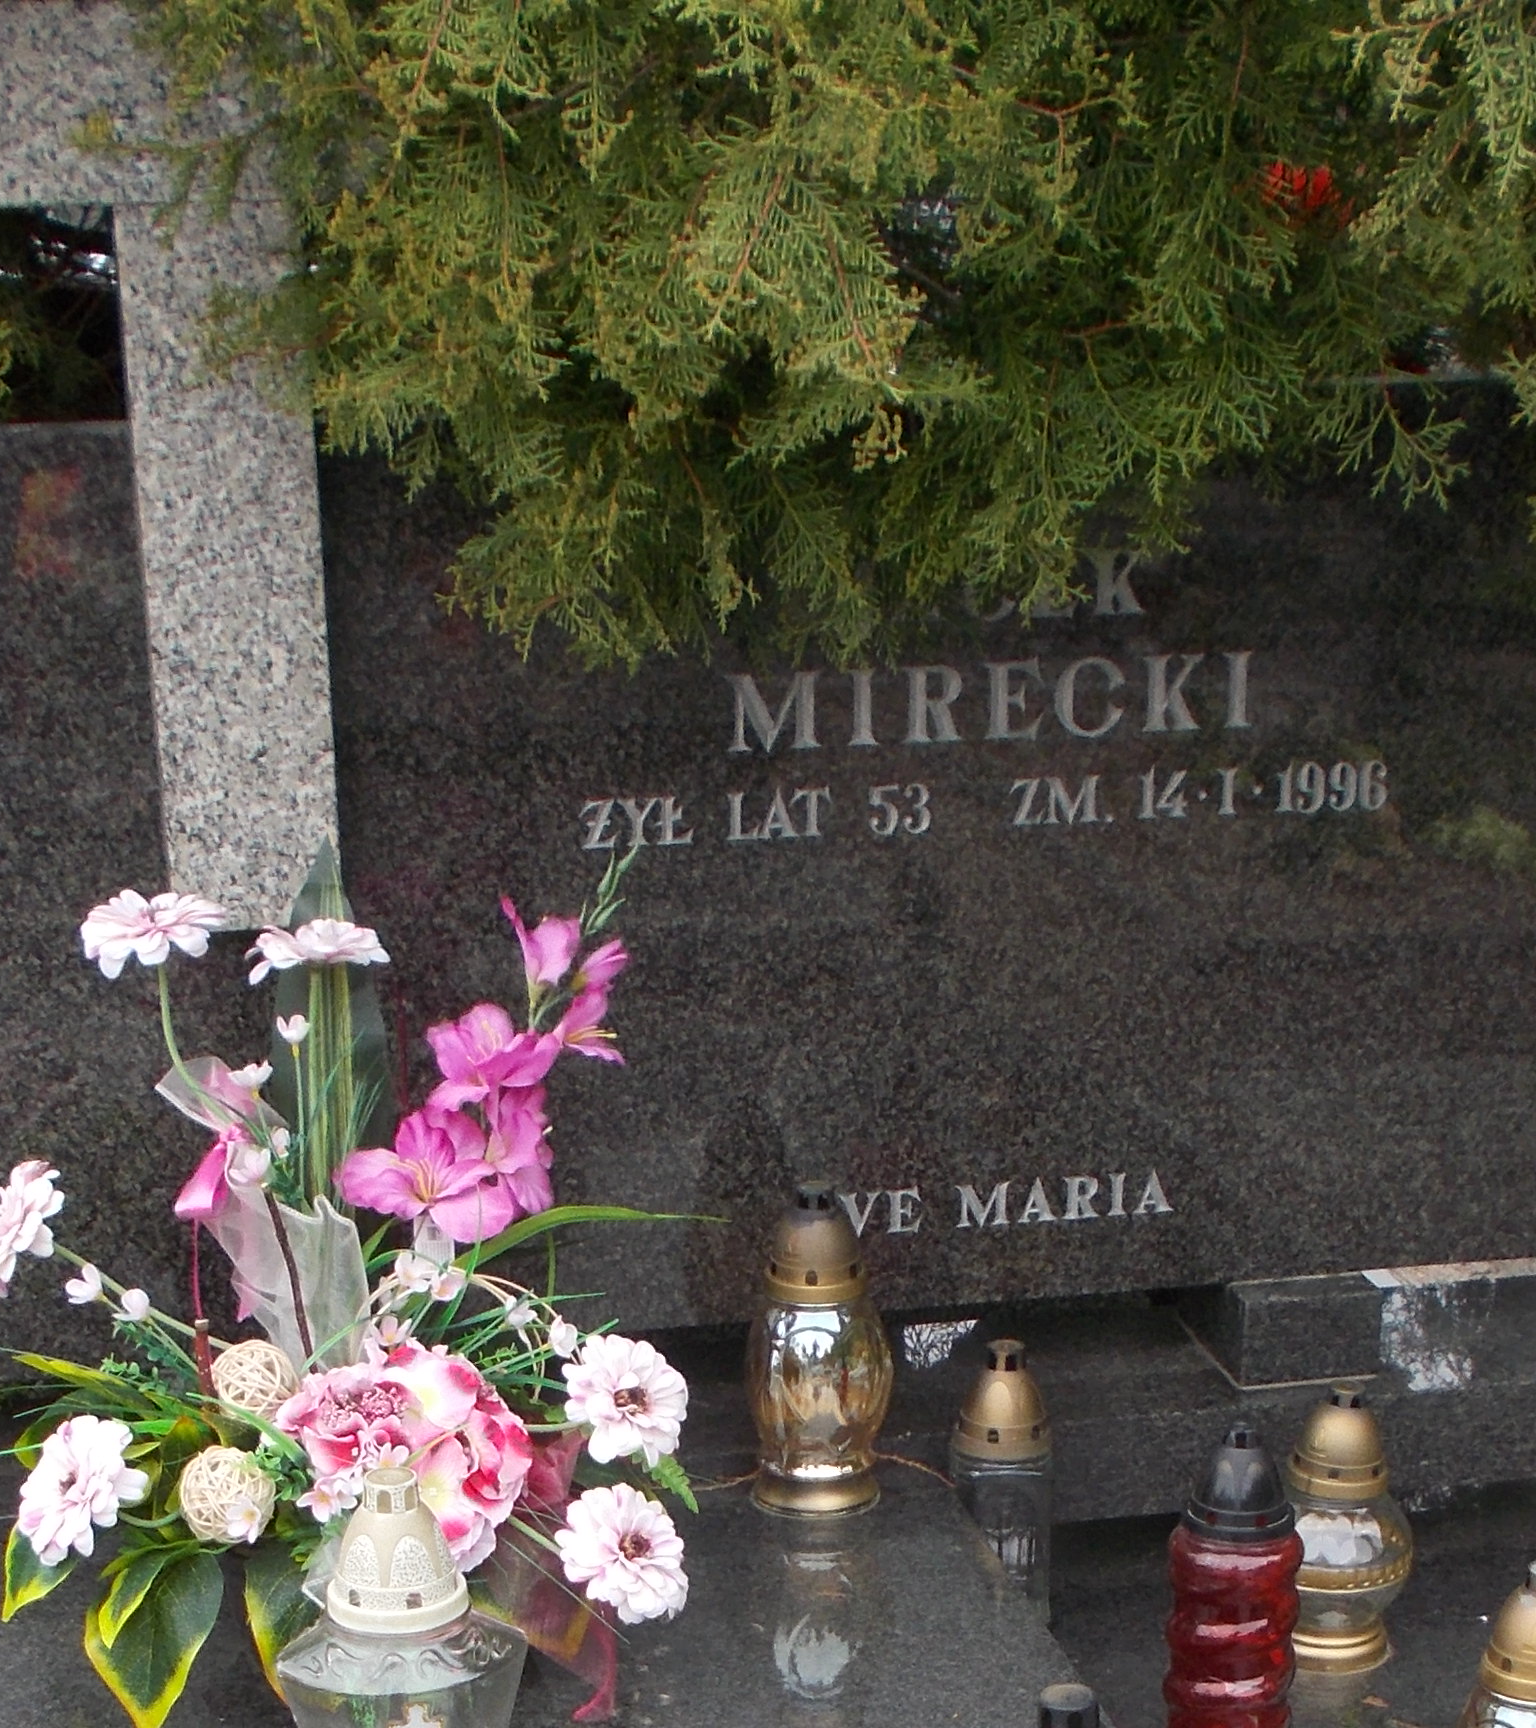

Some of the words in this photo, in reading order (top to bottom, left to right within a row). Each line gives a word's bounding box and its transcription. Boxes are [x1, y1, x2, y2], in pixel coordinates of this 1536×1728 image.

[724, 650, 1254, 753] MIRECKI
[726, 785, 832, 842] LAT
[868, 782, 931, 836] 53
[1009, 774, 1115, 826] ZM.
[838, 1184, 923, 1238] VE
[955, 1168, 1175, 1229] MARIA
